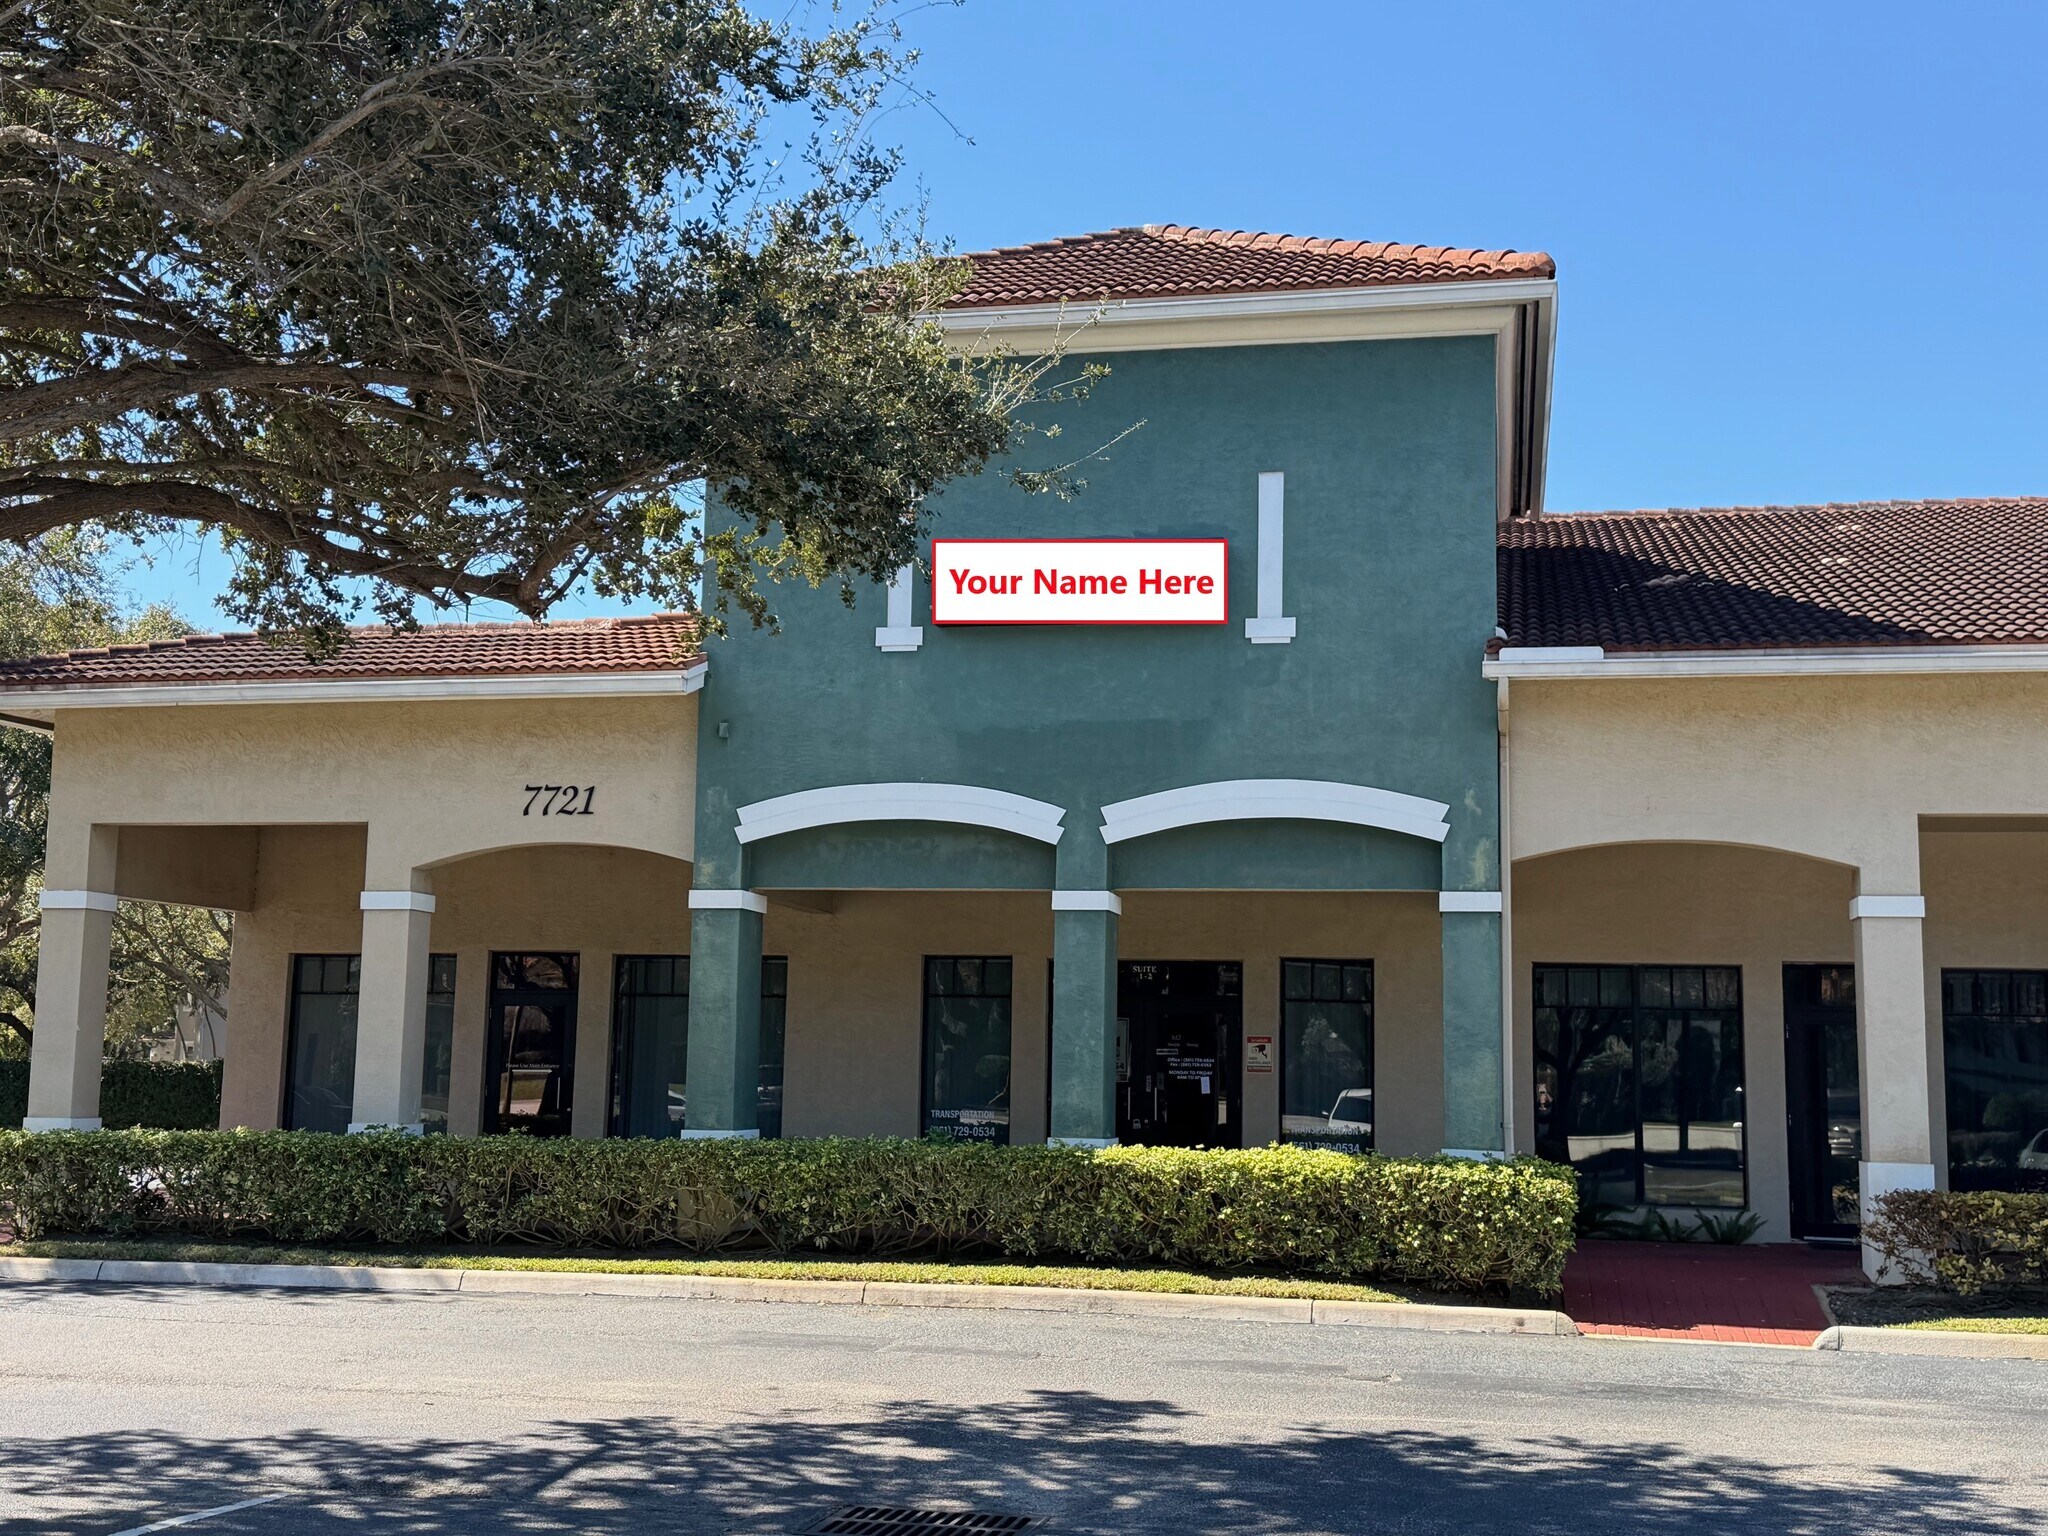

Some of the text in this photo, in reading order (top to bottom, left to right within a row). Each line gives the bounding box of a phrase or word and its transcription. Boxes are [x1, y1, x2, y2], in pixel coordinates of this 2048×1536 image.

[949, 568, 1215, 595] Your Name Here
[523, 784, 595, 816] 7721
[1132, 965, 1157, 973] SUITE
[930, 1109, 995, 1119] TRANSPORTATION
[953, 1126, 996, 1137] 729-0534
[1290, 1125, 1359, 1135] TRANSPORTATION
